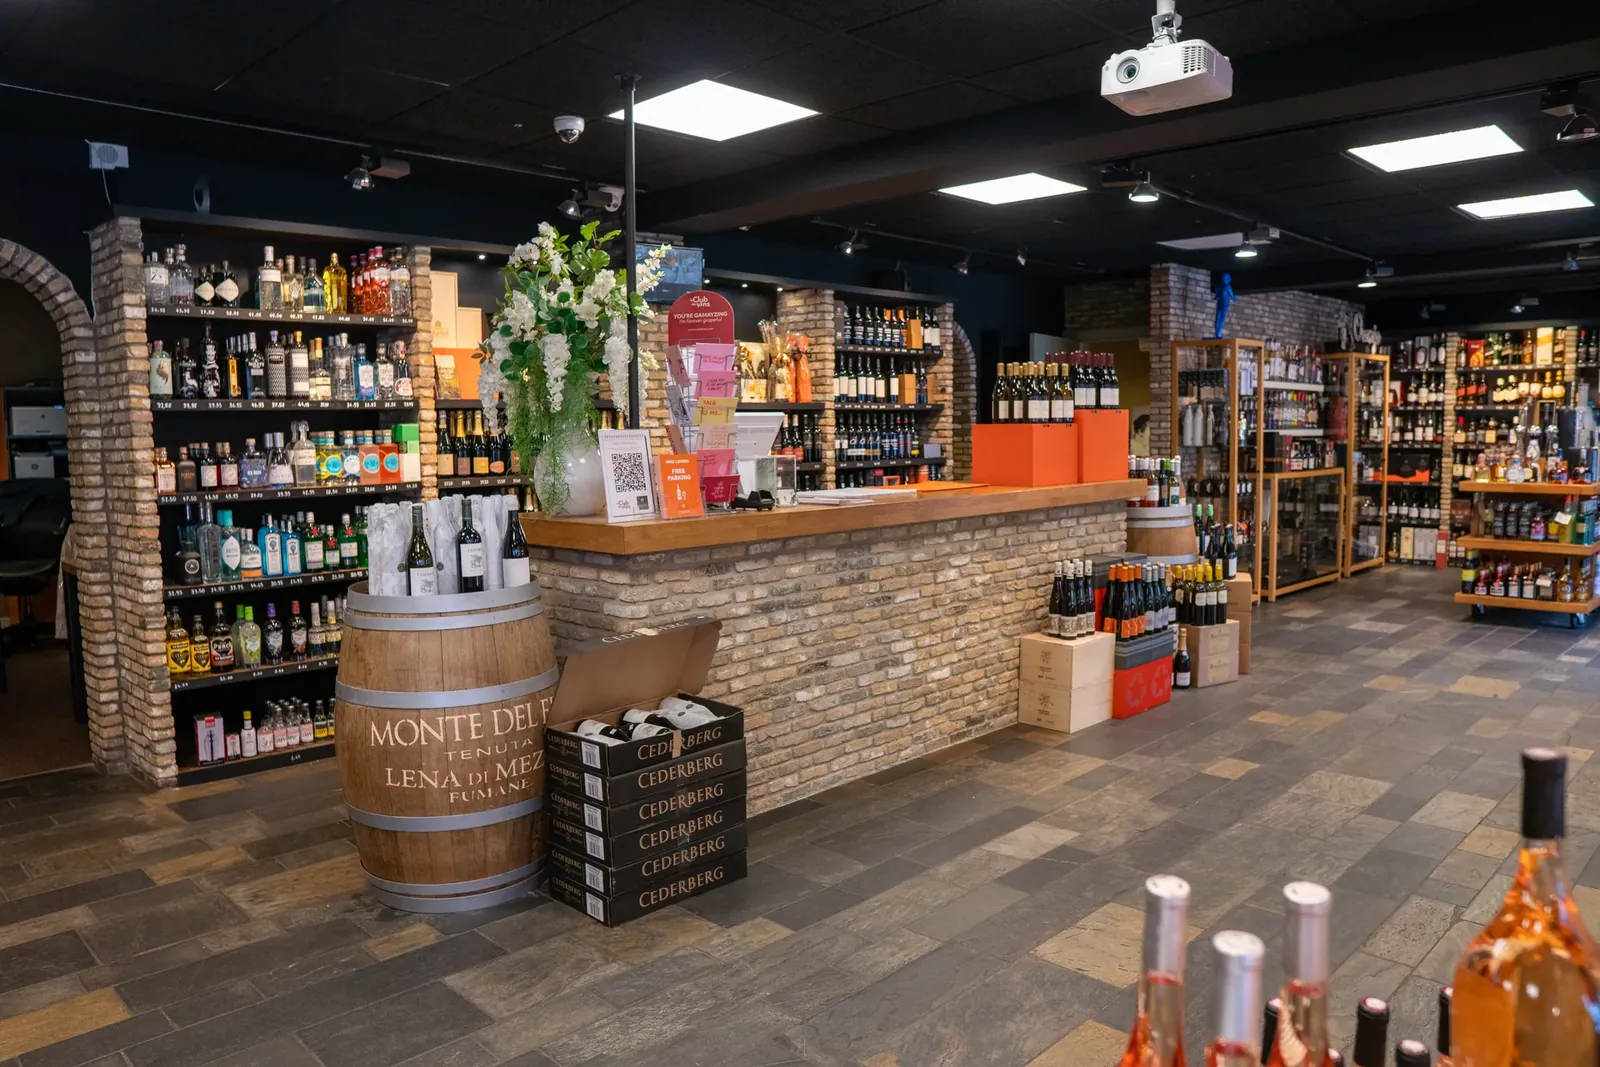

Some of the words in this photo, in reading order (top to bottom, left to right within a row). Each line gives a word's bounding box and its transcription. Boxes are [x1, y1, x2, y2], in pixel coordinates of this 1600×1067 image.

[692, 295, 709, 303] Club
[370, 712, 484, 746] MONTE
[491, 702, 539, 736] DEL
[540, 695, 554, 725] F
[444, 738, 533, 761] TENUTA
[547, 733, 578, 748] CEDERBERG
[385, 768, 462, 789] LENA
[468, 770, 488, 786] DI
[495, 750, 545, 781] MEZ
[549, 763, 580, 779] CEDERBERG
[638, 752, 723, 789] CEDERBERG
[450, 777, 532, 803] FUMANE
[639, 782, 724, 820] CEDERBERG
[639, 810, 723, 850] CEDERBERG
[641, 835, 725, 877] CEDERBERG
[639, 866, 724, 908] CEDERBERG
